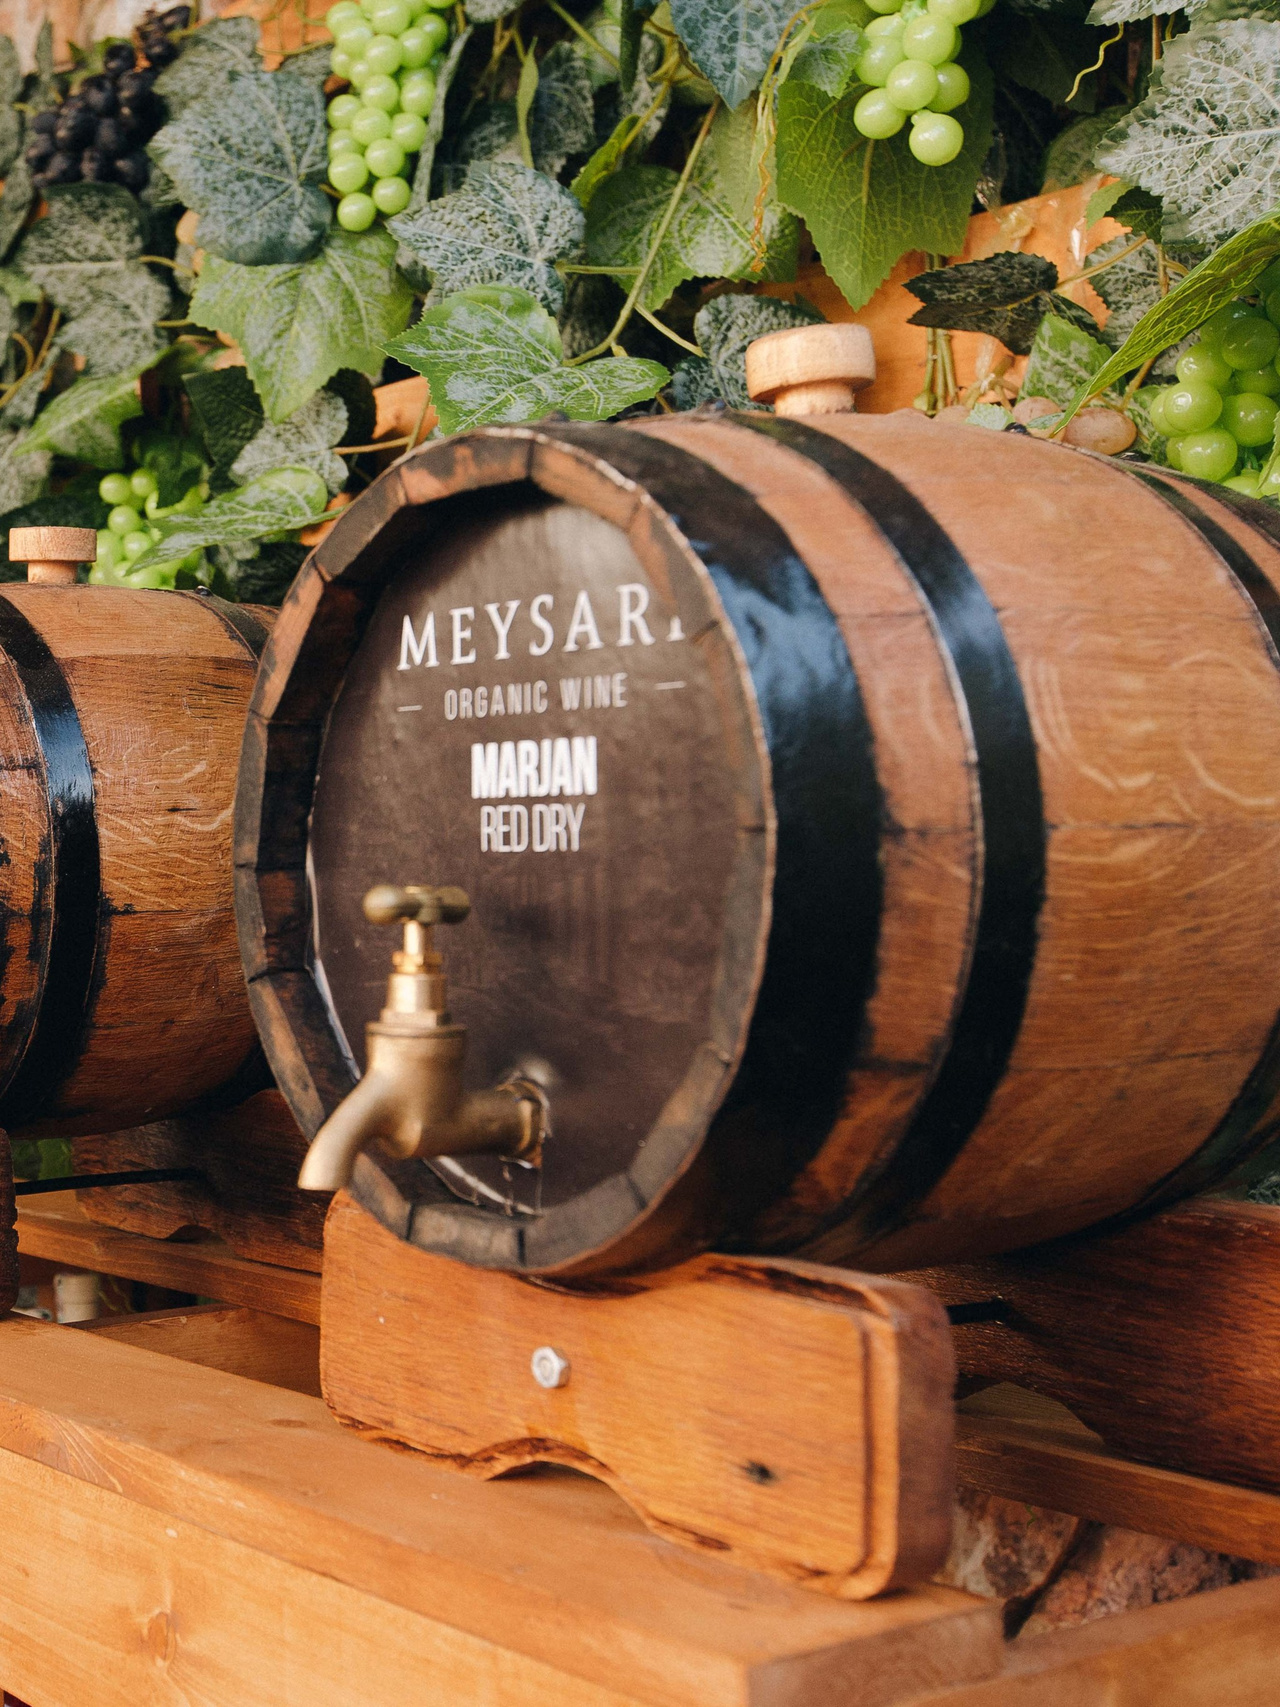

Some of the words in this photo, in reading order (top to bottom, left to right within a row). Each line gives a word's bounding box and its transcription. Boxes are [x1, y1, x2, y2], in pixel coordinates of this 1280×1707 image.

[443, 680, 549, 721] ORGANIC
[559, 672, 628, 711] WINE
[471, 735, 598, 799] MARJAN
[480, 804, 529, 853] RED
[532, 802, 586, 852] DRY
